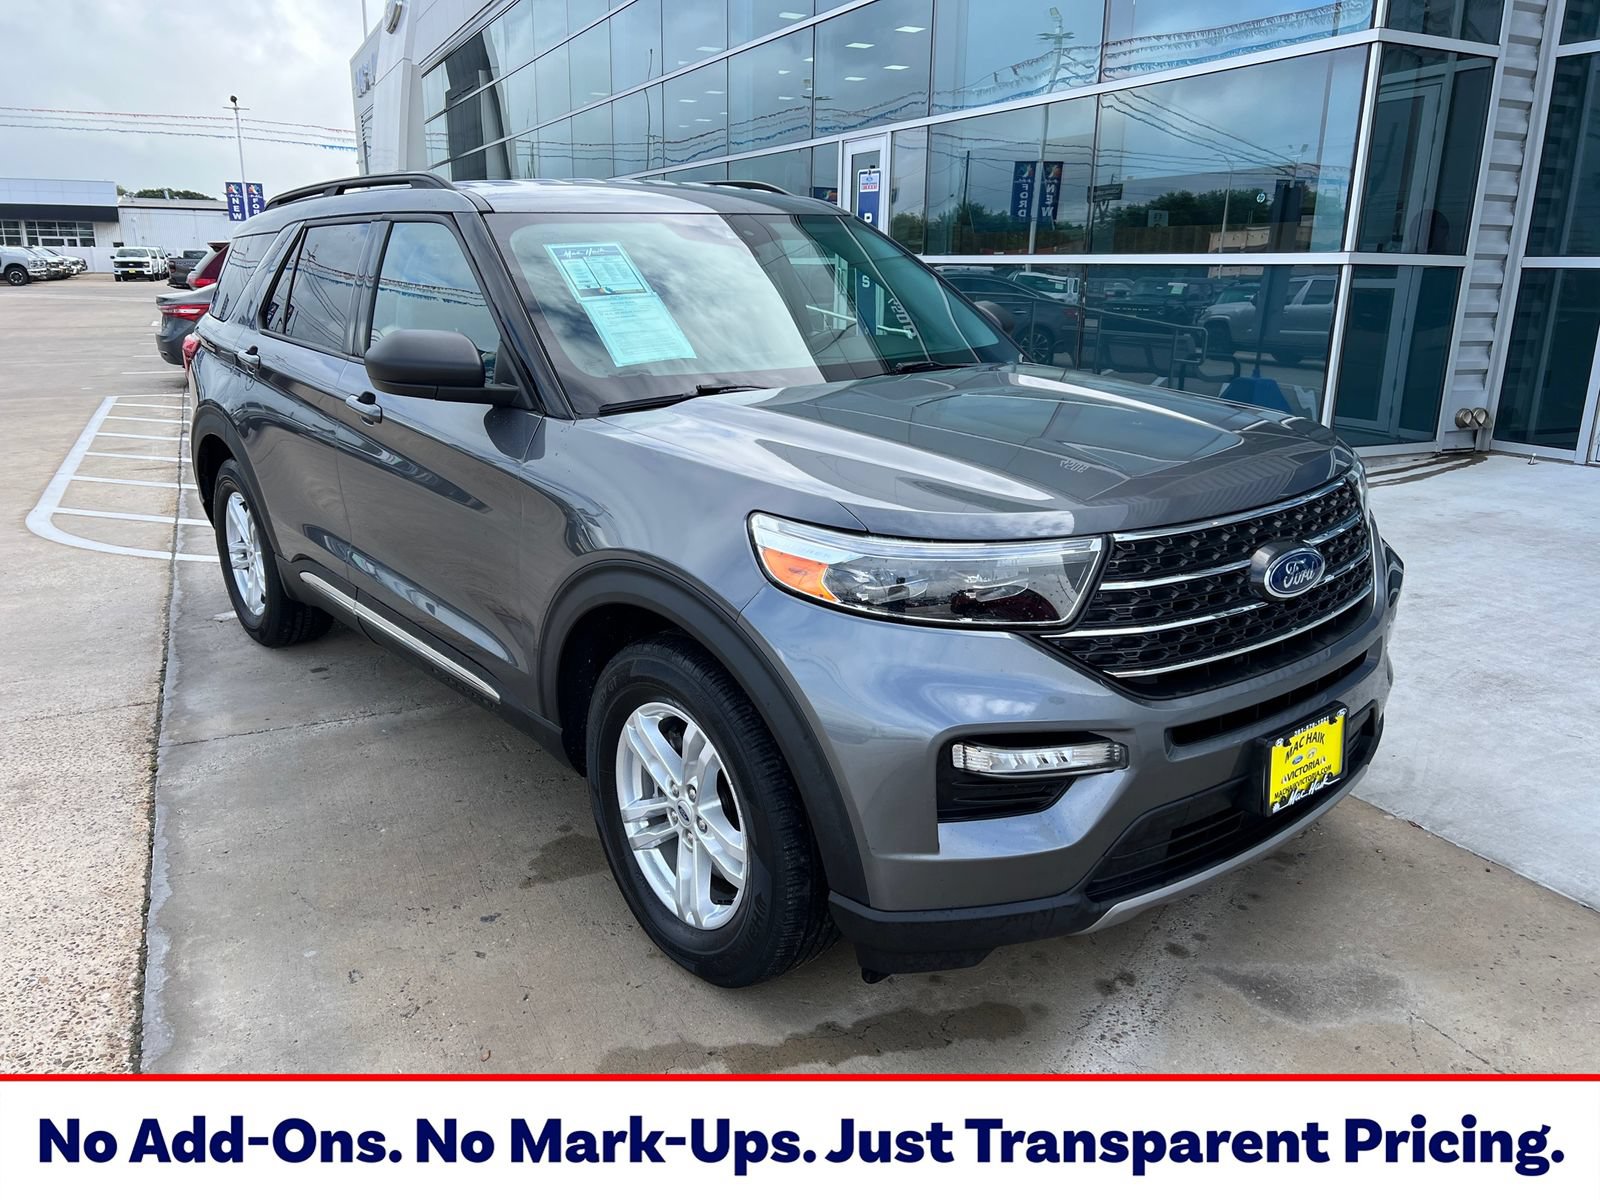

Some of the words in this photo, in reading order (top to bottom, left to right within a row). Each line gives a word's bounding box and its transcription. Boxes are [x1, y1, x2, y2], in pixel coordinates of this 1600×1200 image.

[232, 197, 242, 219] NEW
[1283, 558, 1315, 589] Ford
[1285, 735, 1305, 764] MAC
[1306, 731, 1325, 745] HAIK
[1286, 758, 1321, 781] VICTORIA
[1287, 788, 1309, 806] Mac
